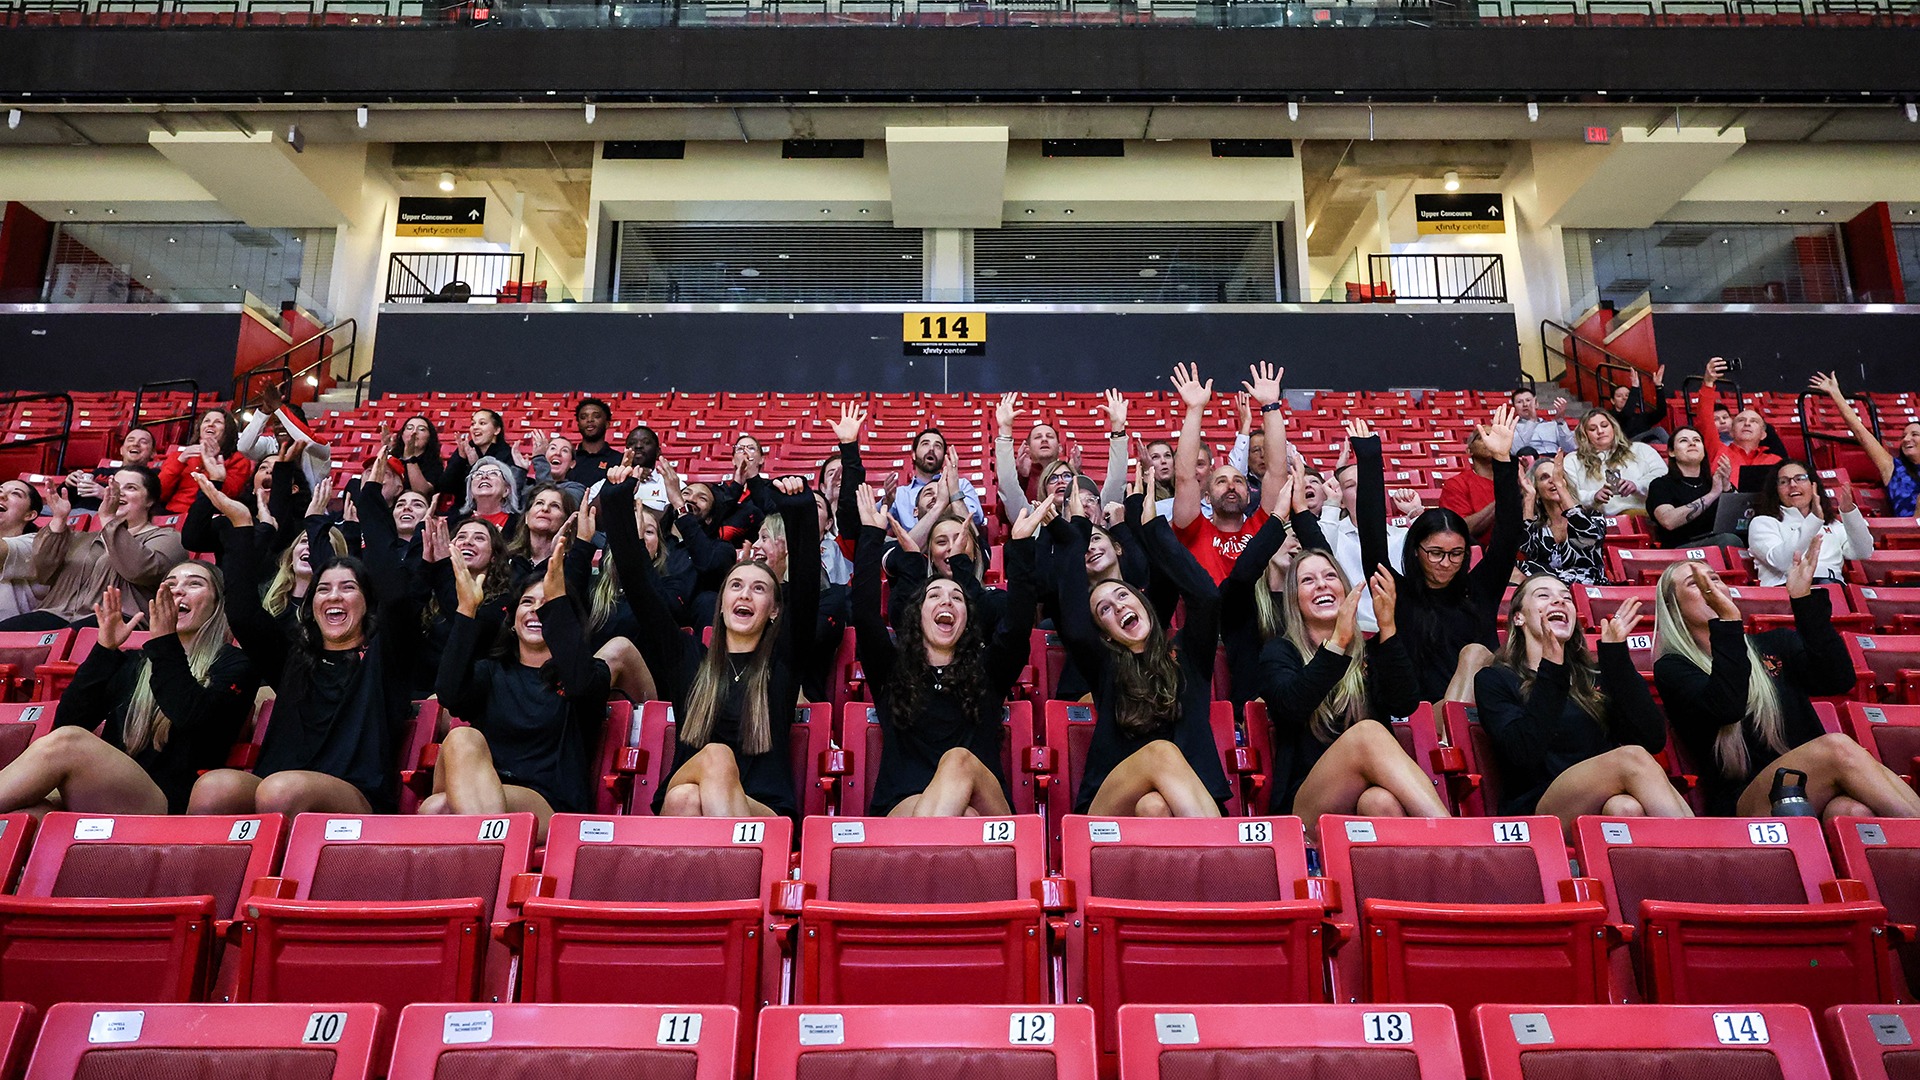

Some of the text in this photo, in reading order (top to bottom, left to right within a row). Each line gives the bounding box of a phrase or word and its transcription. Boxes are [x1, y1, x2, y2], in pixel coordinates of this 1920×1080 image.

[1588, 126, 1608, 141] EXIT
[401, 213, 453, 221] Upper Concourse
[1420, 209, 1473, 219] Upper Concourse
[413, 226, 438, 235] xfinity
[1435, 223, 1460, 231] xfinity
[920, 316, 969, 338] 114
[651, 489, 660, 497] M
[1394, 518, 1404, 526] 16
[1823, 526, 1833, 534] M
[1690, 550, 1703, 559] 18
[44, 633, 53, 644] 6
[1631, 636, 1647, 648] 16
[28, 707, 38, 720] 7
[238, 821, 251, 839] 9
[483, 820, 504, 839] 10
[738, 824, 757, 842] 11
[988, 822, 1009, 841] 12
[1245, 823, 1266, 842] 13
[1500, 823, 1524, 842] 14
[1755, 824, 1780, 843] 15
[309, 1014, 339, 1042] 10
[665, 1015, 690, 1042] 11
[1017, 1015, 1046, 1041] 12
[1372, 1014, 1403, 1041] 13
[1724, 1015, 1759, 1041] 14
